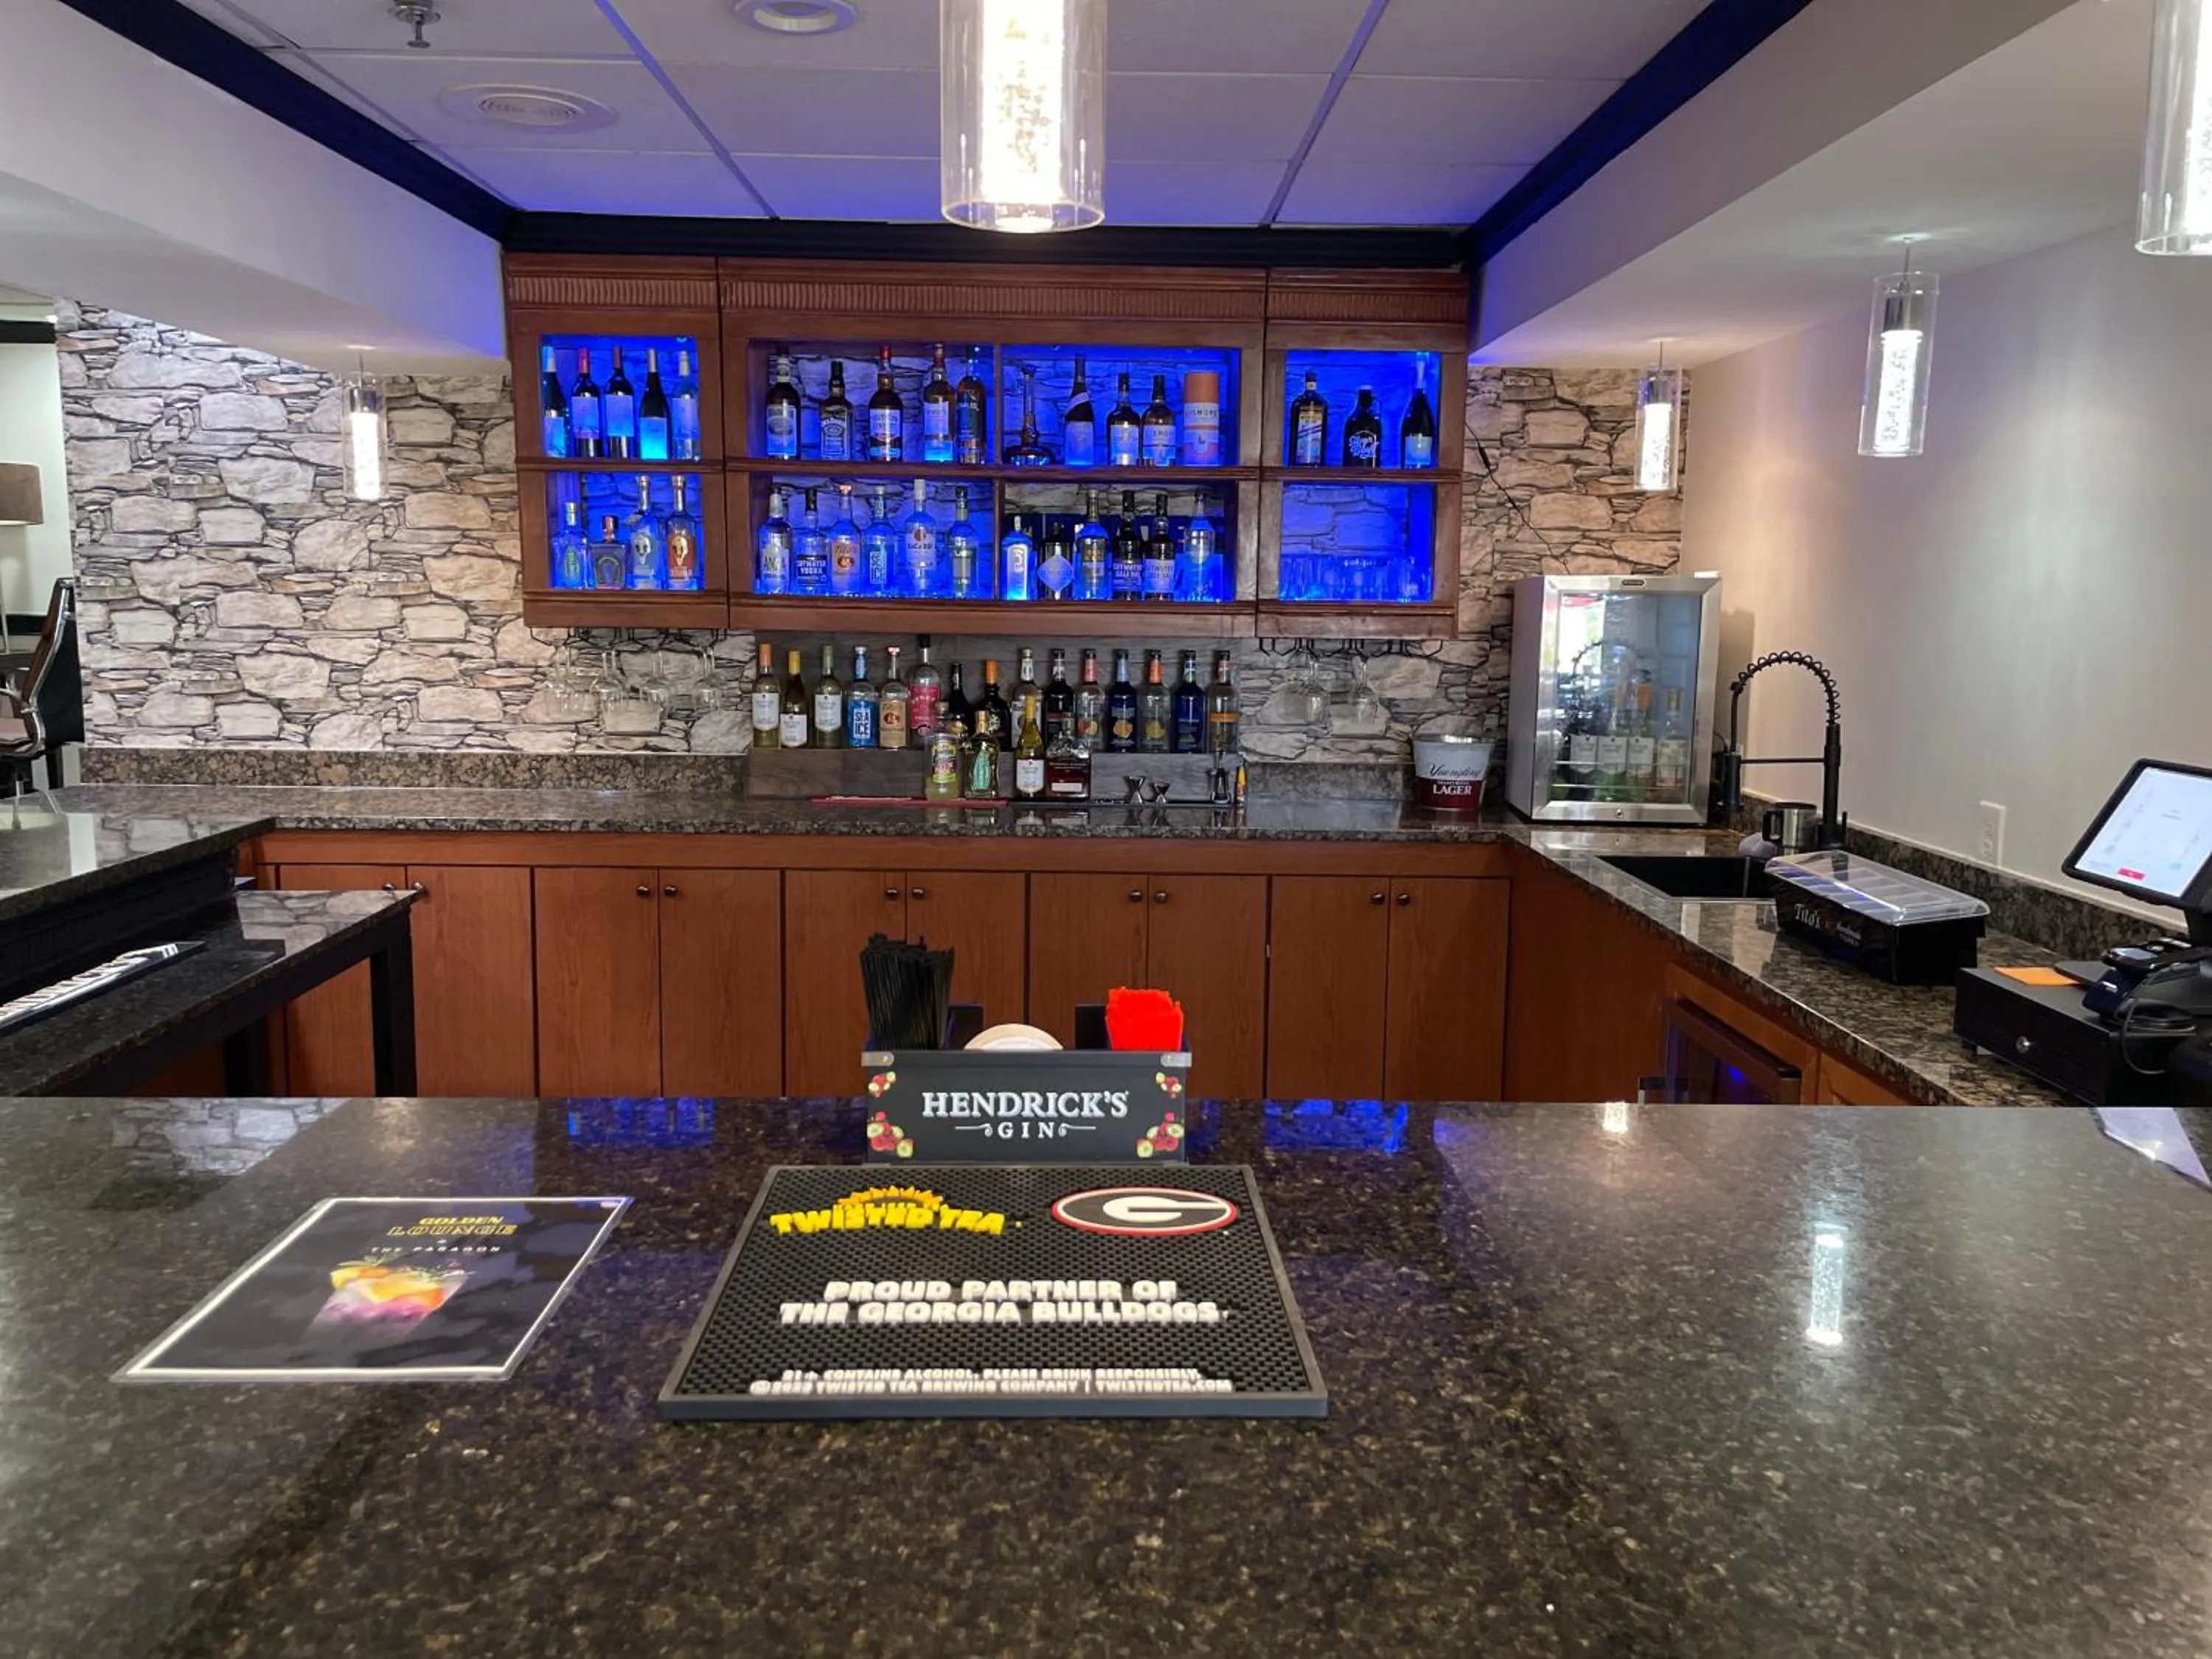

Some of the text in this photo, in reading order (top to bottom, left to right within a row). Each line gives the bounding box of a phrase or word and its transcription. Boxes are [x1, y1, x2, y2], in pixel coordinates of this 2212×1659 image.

[855, 723, 869, 735] ICE
[1433, 784, 1472, 796] LAGER
[1794, 903, 1821, 928] Tito's
[922, 1091, 1128, 1118] HENDRICK'S
[997, 1121, 1055, 1139] GIN
[770, 1203, 1005, 1235] TWISTED TEA
[824, 1280, 1177, 1301] PROUD PARTNER OF
[780, 1302, 849, 1325] THE
[858, 1301, 1020, 1325] GEORGIA
